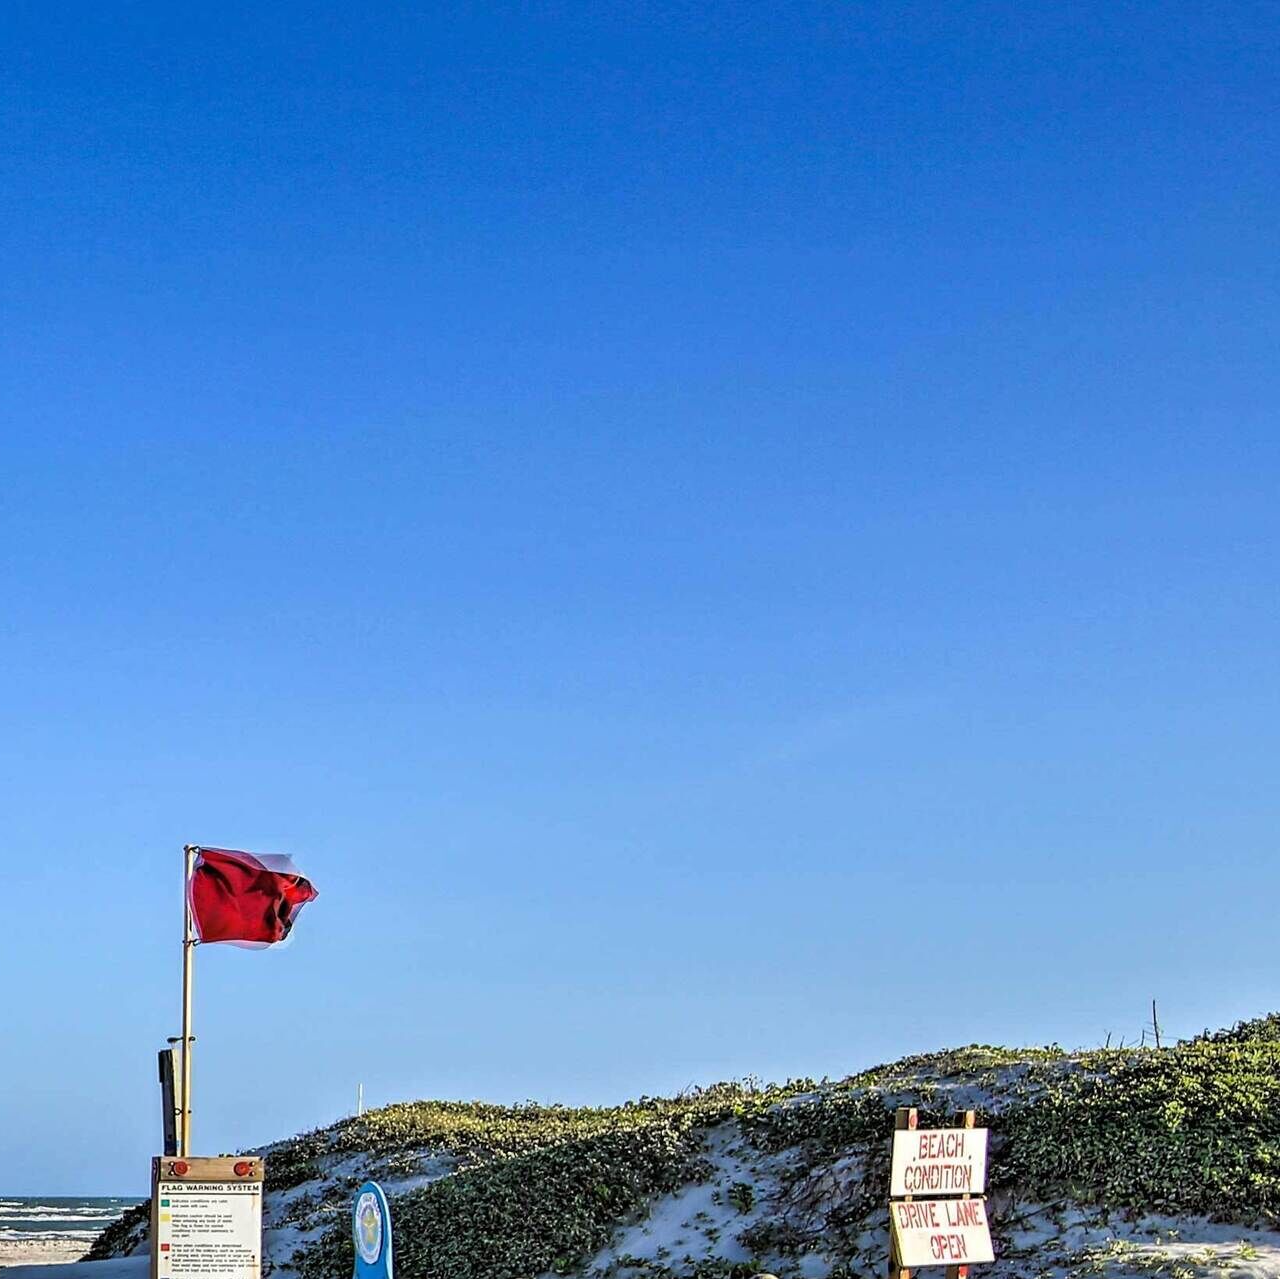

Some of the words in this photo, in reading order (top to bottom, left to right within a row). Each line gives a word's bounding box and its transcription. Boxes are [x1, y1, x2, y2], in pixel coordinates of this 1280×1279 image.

[919, 1133, 964, 1159] BEACH
[904, 1165, 972, 1190] CONDITION
[898, 1203, 940, 1229] DRIVE
[945, 1202, 983, 1226] LANE
[930, 1234, 968, 1259] OPEN
